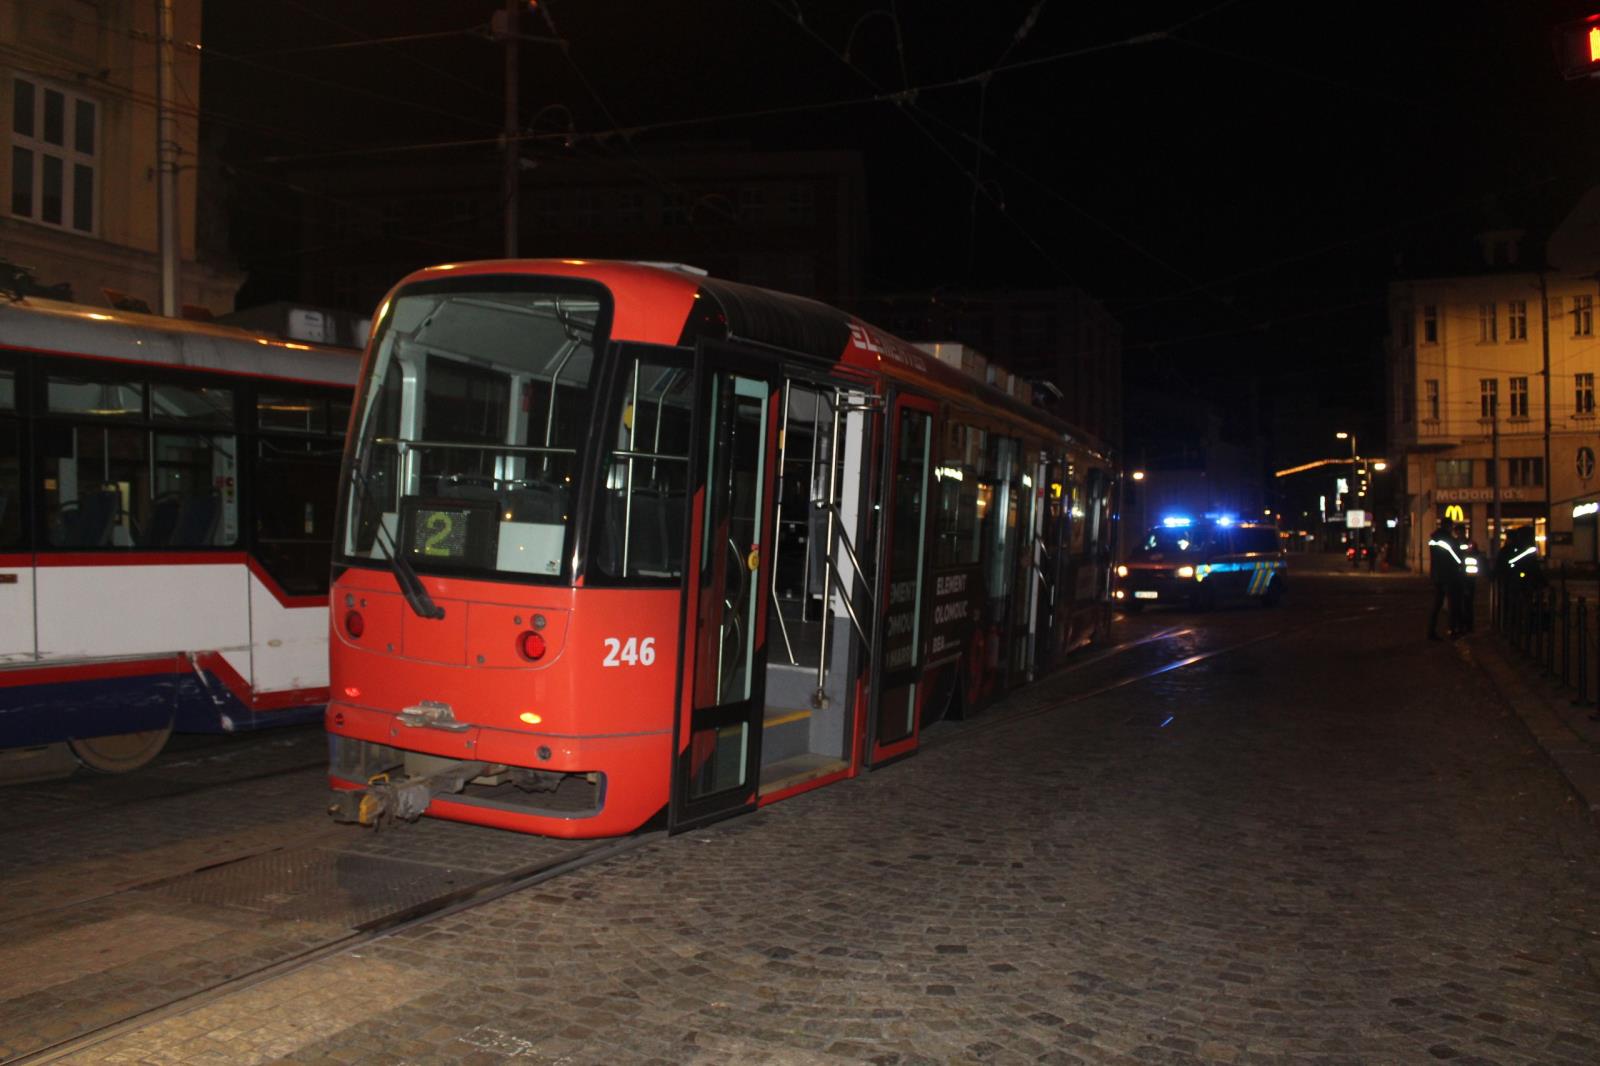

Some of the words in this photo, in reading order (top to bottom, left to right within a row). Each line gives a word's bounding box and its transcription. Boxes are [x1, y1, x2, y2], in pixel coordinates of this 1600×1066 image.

[1436, 488, 1524, 501] McDonld's
[425, 511, 453, 556] 2
[936, 574, 968, 596] ELEMENT
[934, 600, 968, 624] OLOMOUC
[602, 636, 656, 667] 246
